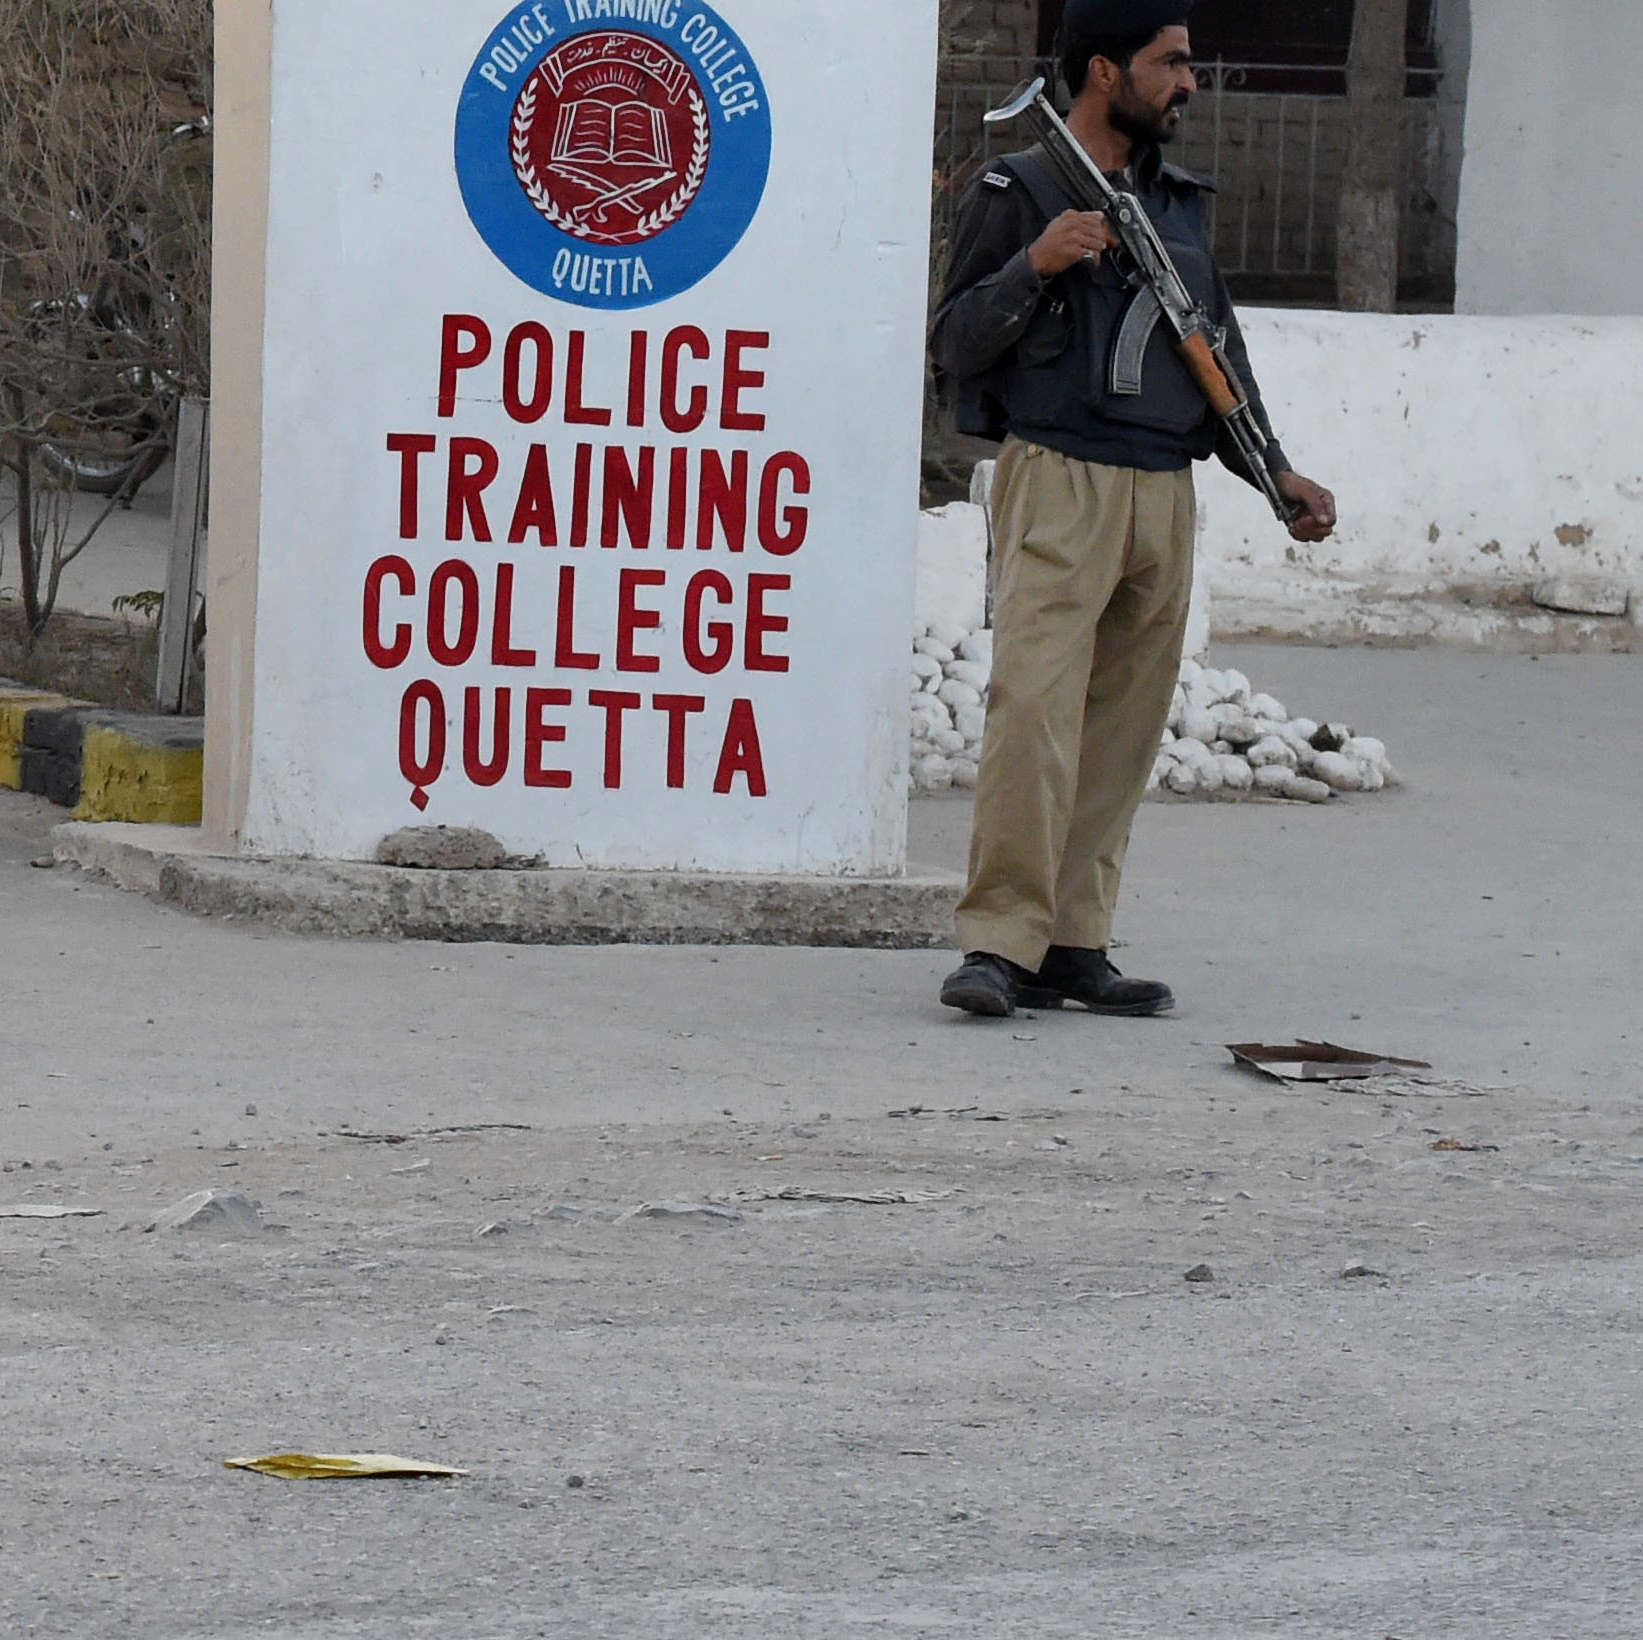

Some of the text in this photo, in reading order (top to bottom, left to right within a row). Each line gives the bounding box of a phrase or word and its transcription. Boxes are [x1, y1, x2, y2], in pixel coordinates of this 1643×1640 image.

[479, 3, 556, 92] POLICE
[680, 13, 759, 123] COLLEGE
[551, 248, 653, 296] QUETTA
[438, 315, 769, 432] POLICE
[388, 434, 810, 556] TRAINING
[363, 556, 791, 673] COLLEGE
[399, 680, 767, 809] QUETTA
